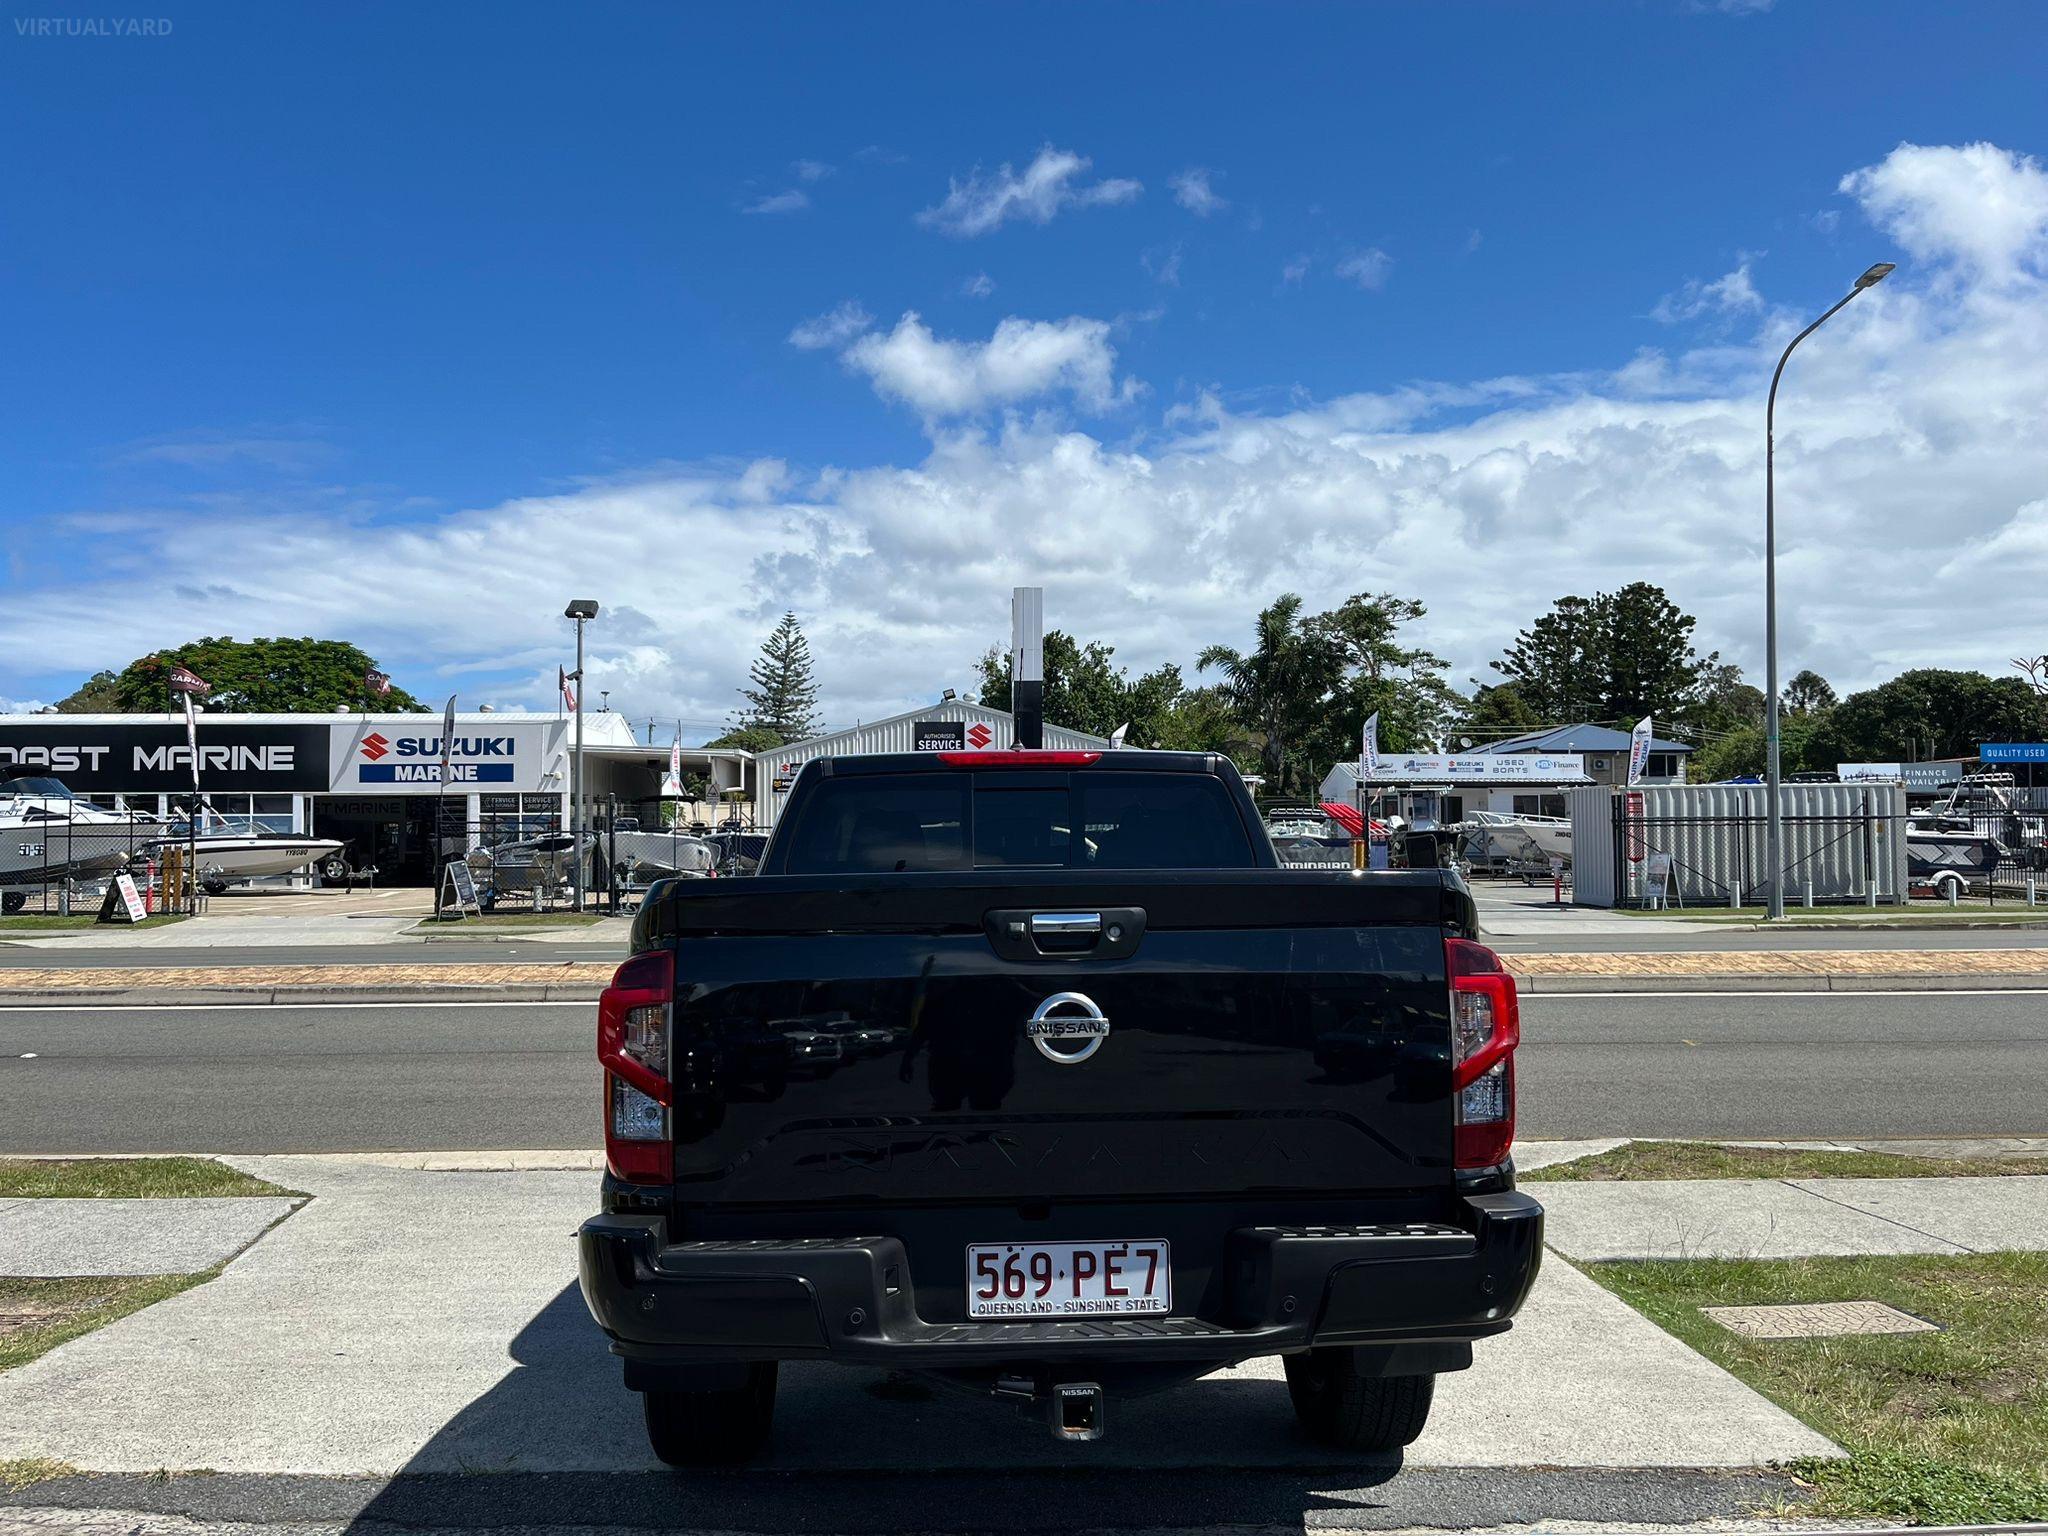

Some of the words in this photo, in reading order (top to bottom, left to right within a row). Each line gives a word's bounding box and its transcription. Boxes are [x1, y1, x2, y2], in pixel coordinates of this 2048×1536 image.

[396, 738, 514, 756] SUZUKI
[918, 740, 961, 750] SERVICE
[133, 746, 295, 771] MARINE
[1630, 740, 1640, 781] QUINTREX
[1987, 749, 2021, 757] QUALITY
[2024, 749, 2045, 757] USED
[394, 766, 478, 781] MARNE
[1905, 769, 1947, 777] FINANCE
[1036, 1023, 1101, 1034] NISSAN
[976, 1252, 1052, 1299] 569
[1072, 1248, 1159, 1298] PE7
[977, 1301, 1053, 1315] QUEENSLAND
[1064, 1299, 1121, 1313] SUNSHINE
[1126, 1299, 1161, 1311] STATE
[1061, 1388, 1095, 1396] NISSAN
